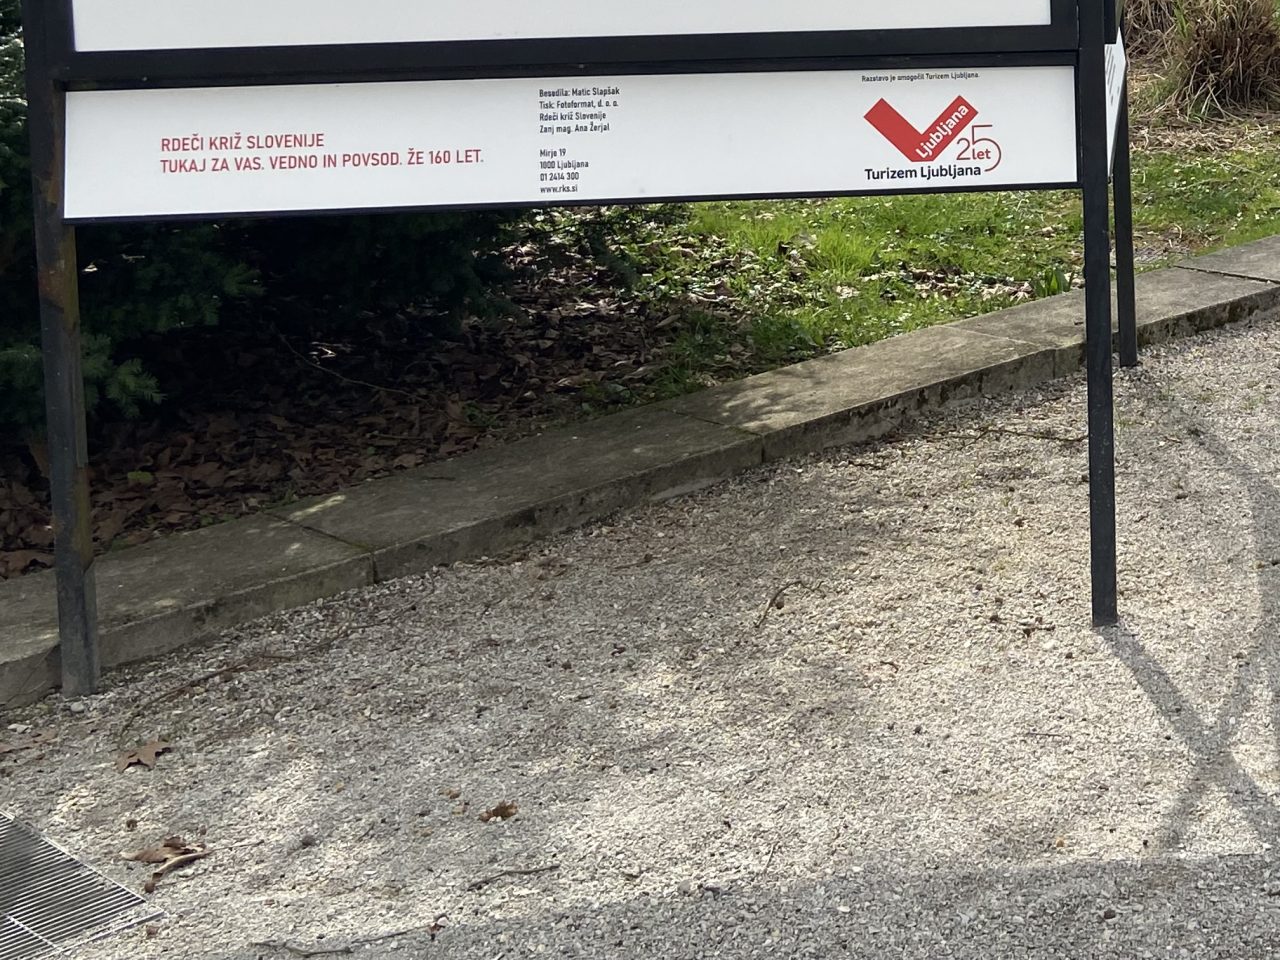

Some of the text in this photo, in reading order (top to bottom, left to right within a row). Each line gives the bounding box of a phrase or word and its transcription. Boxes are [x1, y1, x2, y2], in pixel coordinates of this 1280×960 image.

[539, 86, 620, 97] Besedila: Matic Slapšak
[539, 101, 555, 109] Tisk:
[556, 100, 596, 109] Fotoformat,
[597, 99, 603, 108] d.
[539, 111, 606, 121] Rdeči križ Slovenije
[556, 126, 572, 134] mag.
[590, 121, 610, 132] Žerjal
[915, 105, 969, 159] Ljubljana
[162, 132, 324, 151] RDEČI KRIŽ SLOVENIJE
[539, 148, 566, 159] Mirje 19
[972, 148, 991, 160] let
[160, 148, 484, 173] TUKAJ ZA VAS. VEDNO IN POVSOD. ŽE 160 LET.
[540, 160, 589, 170] 1000 Ljubljana
[540, 172, 579, 181] 01 2414 300
[865, 165, 981, 180] Turizem Ljubljana
[540, 185, 578, 193] www.rks.si
